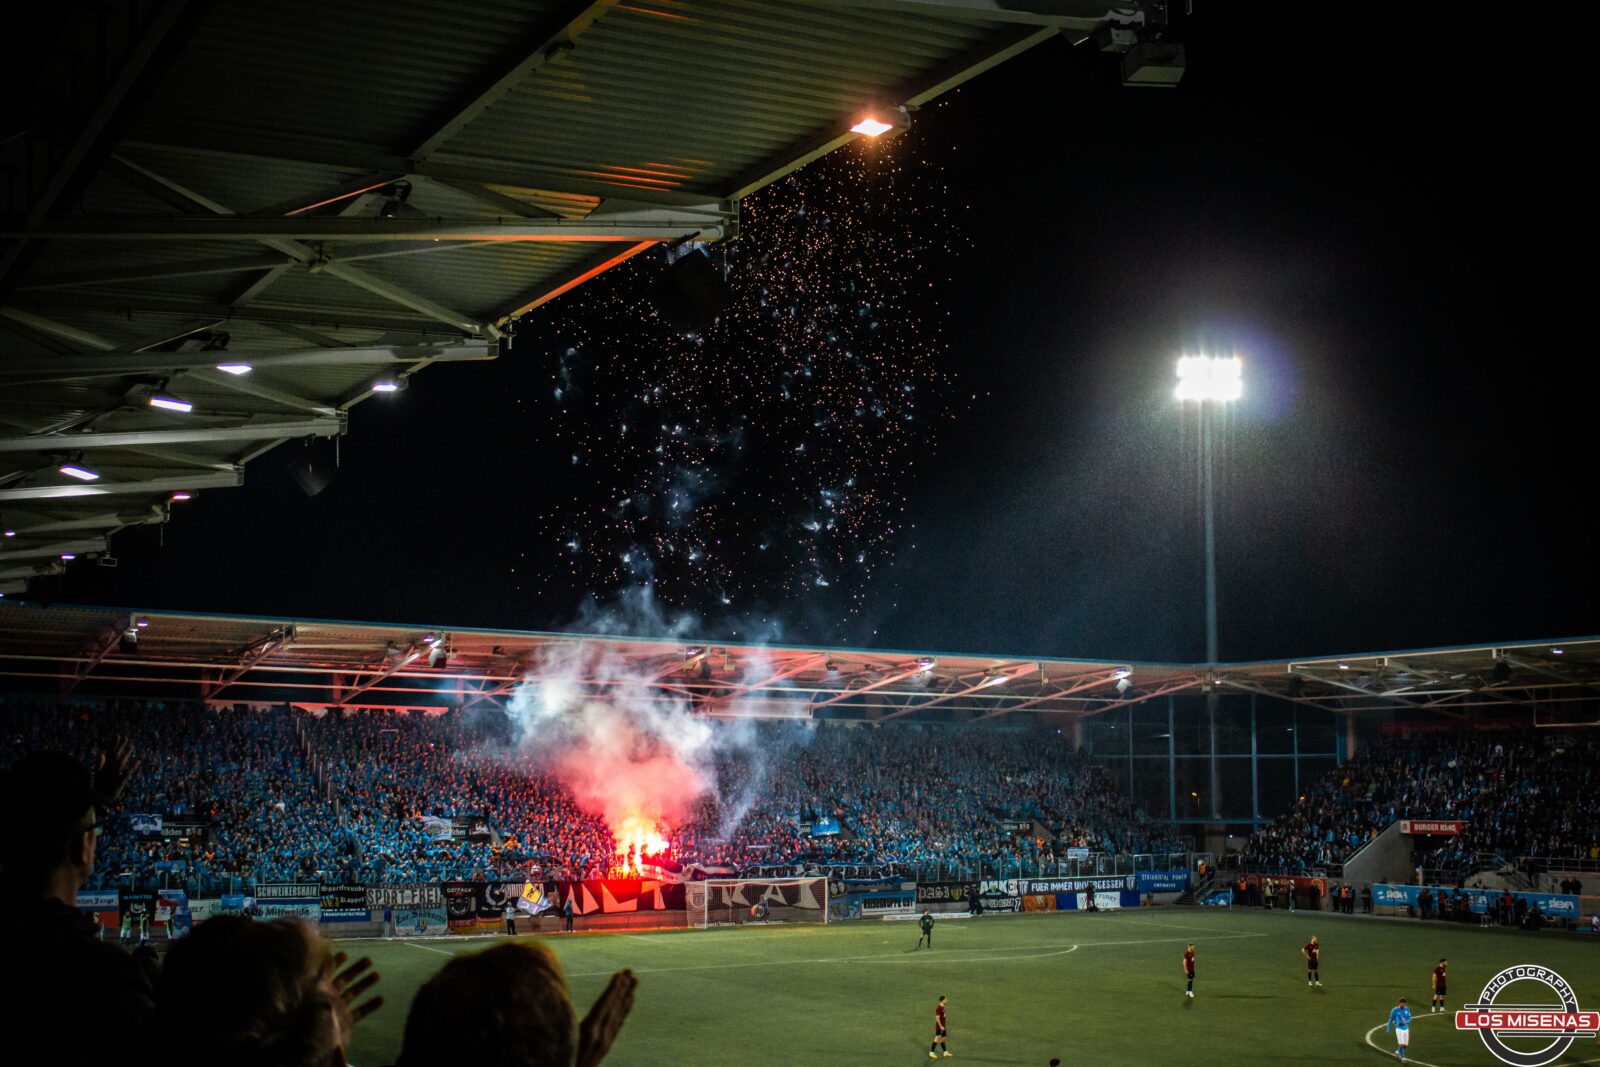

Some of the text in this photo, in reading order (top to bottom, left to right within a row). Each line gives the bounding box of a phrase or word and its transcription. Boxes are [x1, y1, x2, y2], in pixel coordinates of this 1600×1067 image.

[256, 885, 319, 897] SCHWEIKERSHAIN
[1031, 883, 1049, 892] FUER
[1050, 882, 1073, 891] IMMER
[367, 888, 405, 904] SPORT
[903, 897, 914, 907] OST
